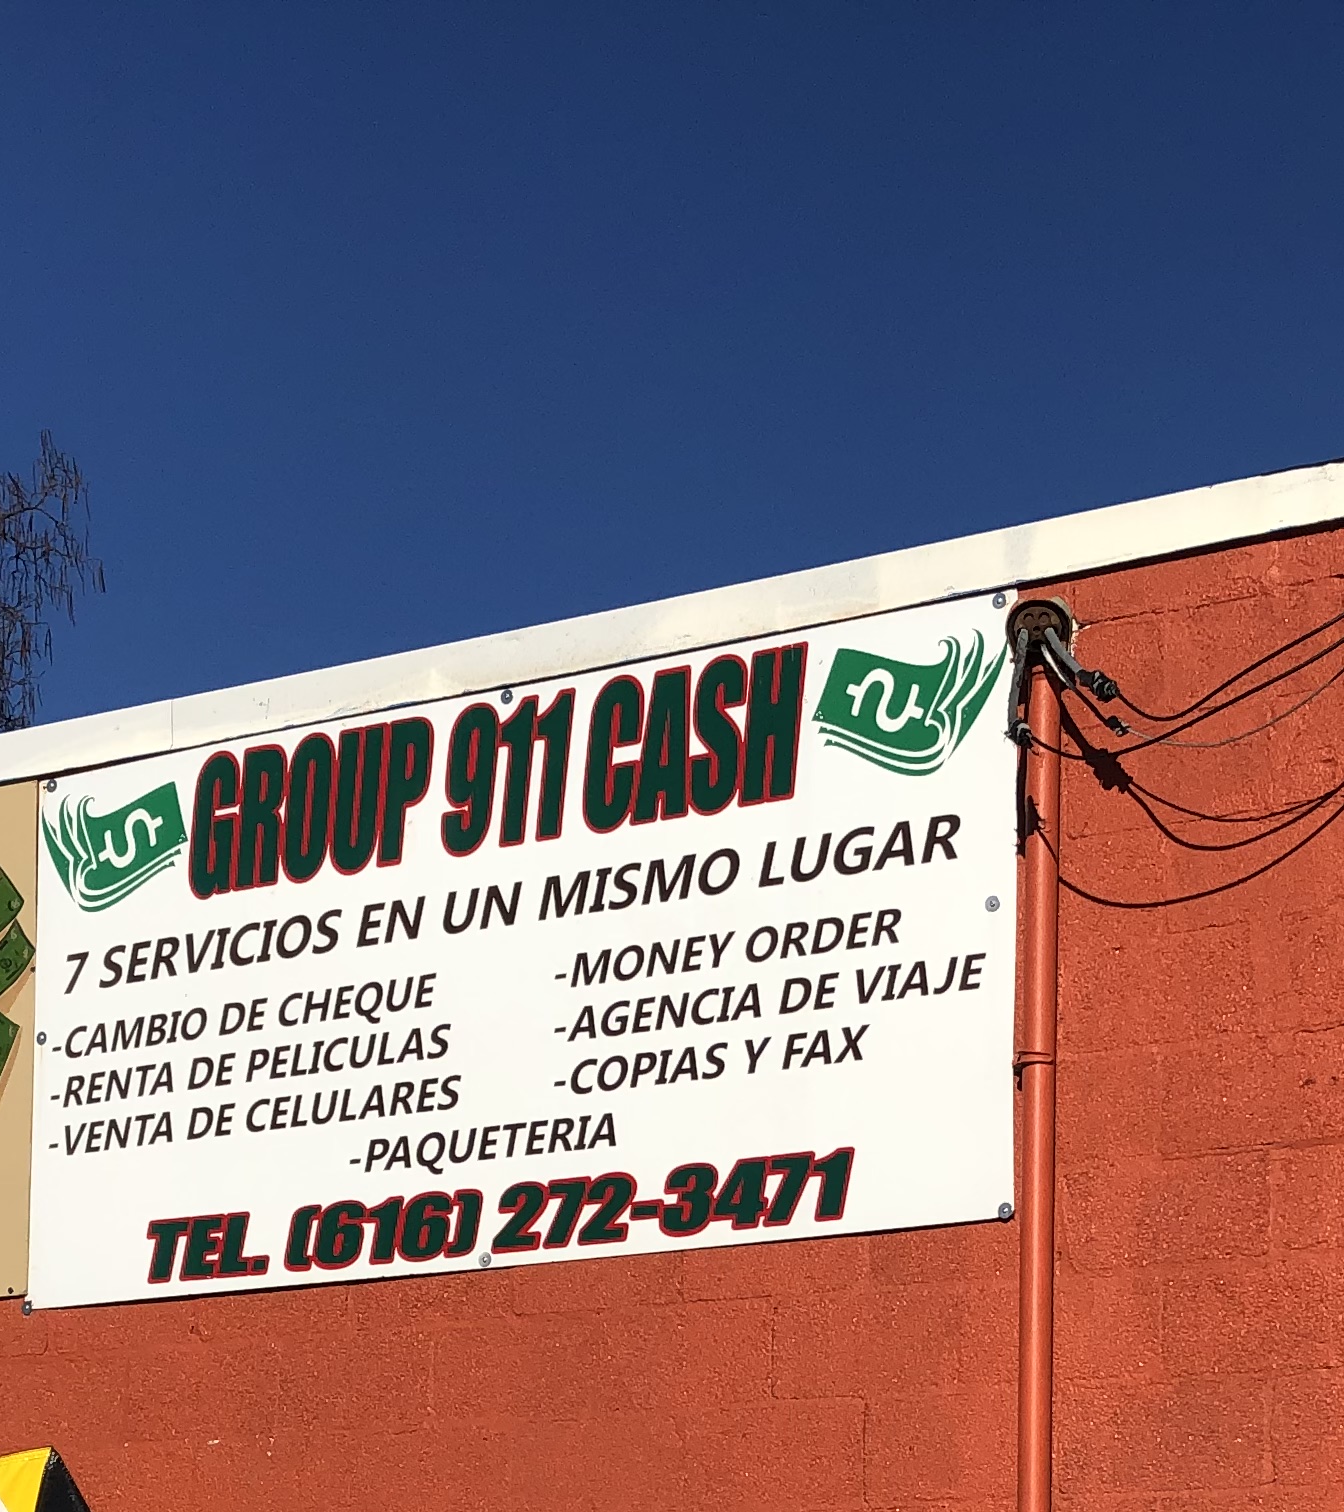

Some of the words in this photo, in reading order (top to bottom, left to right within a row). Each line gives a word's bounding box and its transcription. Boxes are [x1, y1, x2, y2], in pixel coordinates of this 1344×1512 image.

[189, 717, 434, 900] GROUP
[441, 688, 576, 857] 911
[583, 642, 808, 834] CASH
[65, 952, 88, 993] 7
[100, 910, 342, 988] SERVICIOS
[357, 896, 425, 947] EN
[443, 882, 522, 934] UN
[539, 849, 739, 920] MISMO
[759, 815, 960, 887] LUGAR
[555, 932, 734, 987] -MONEY
[746, 909, 901, 962] ORDER
[52, 1008, 207, 1058] -CAMBIO
[219, 998, 267, 1035] DE
[279, 973, 436, 1026] CHEQUE
[555, 984, 761, 1041] -AGENCIA
[779, 973, 839, 1014] DE
[856, 953, 986, 1003] VIAJE
[50, 1062, 173, 1107] -RENTA
[188, 1053, 235, 1089] DE
[246, 1024, 450, 1082] PELICULAS
[554, 1043, 728, 1094] -COPIAS
[745, 1037, 771, 1073] Y
[783, 1025, 869, 1069] FAX
[49, 1112, 172, 1155] -VENTA
[187, 1103, 235, 1139] DE
[247, 1075, 461, 1132] CELULARES
[350, 1113, 616, 1174] -PAQUETERIA
[147, 1212, 269, 1284] TEL.
[284, 1189, 483, 1272] (616)
[491, 1147, 855, 1254] 272-3471
